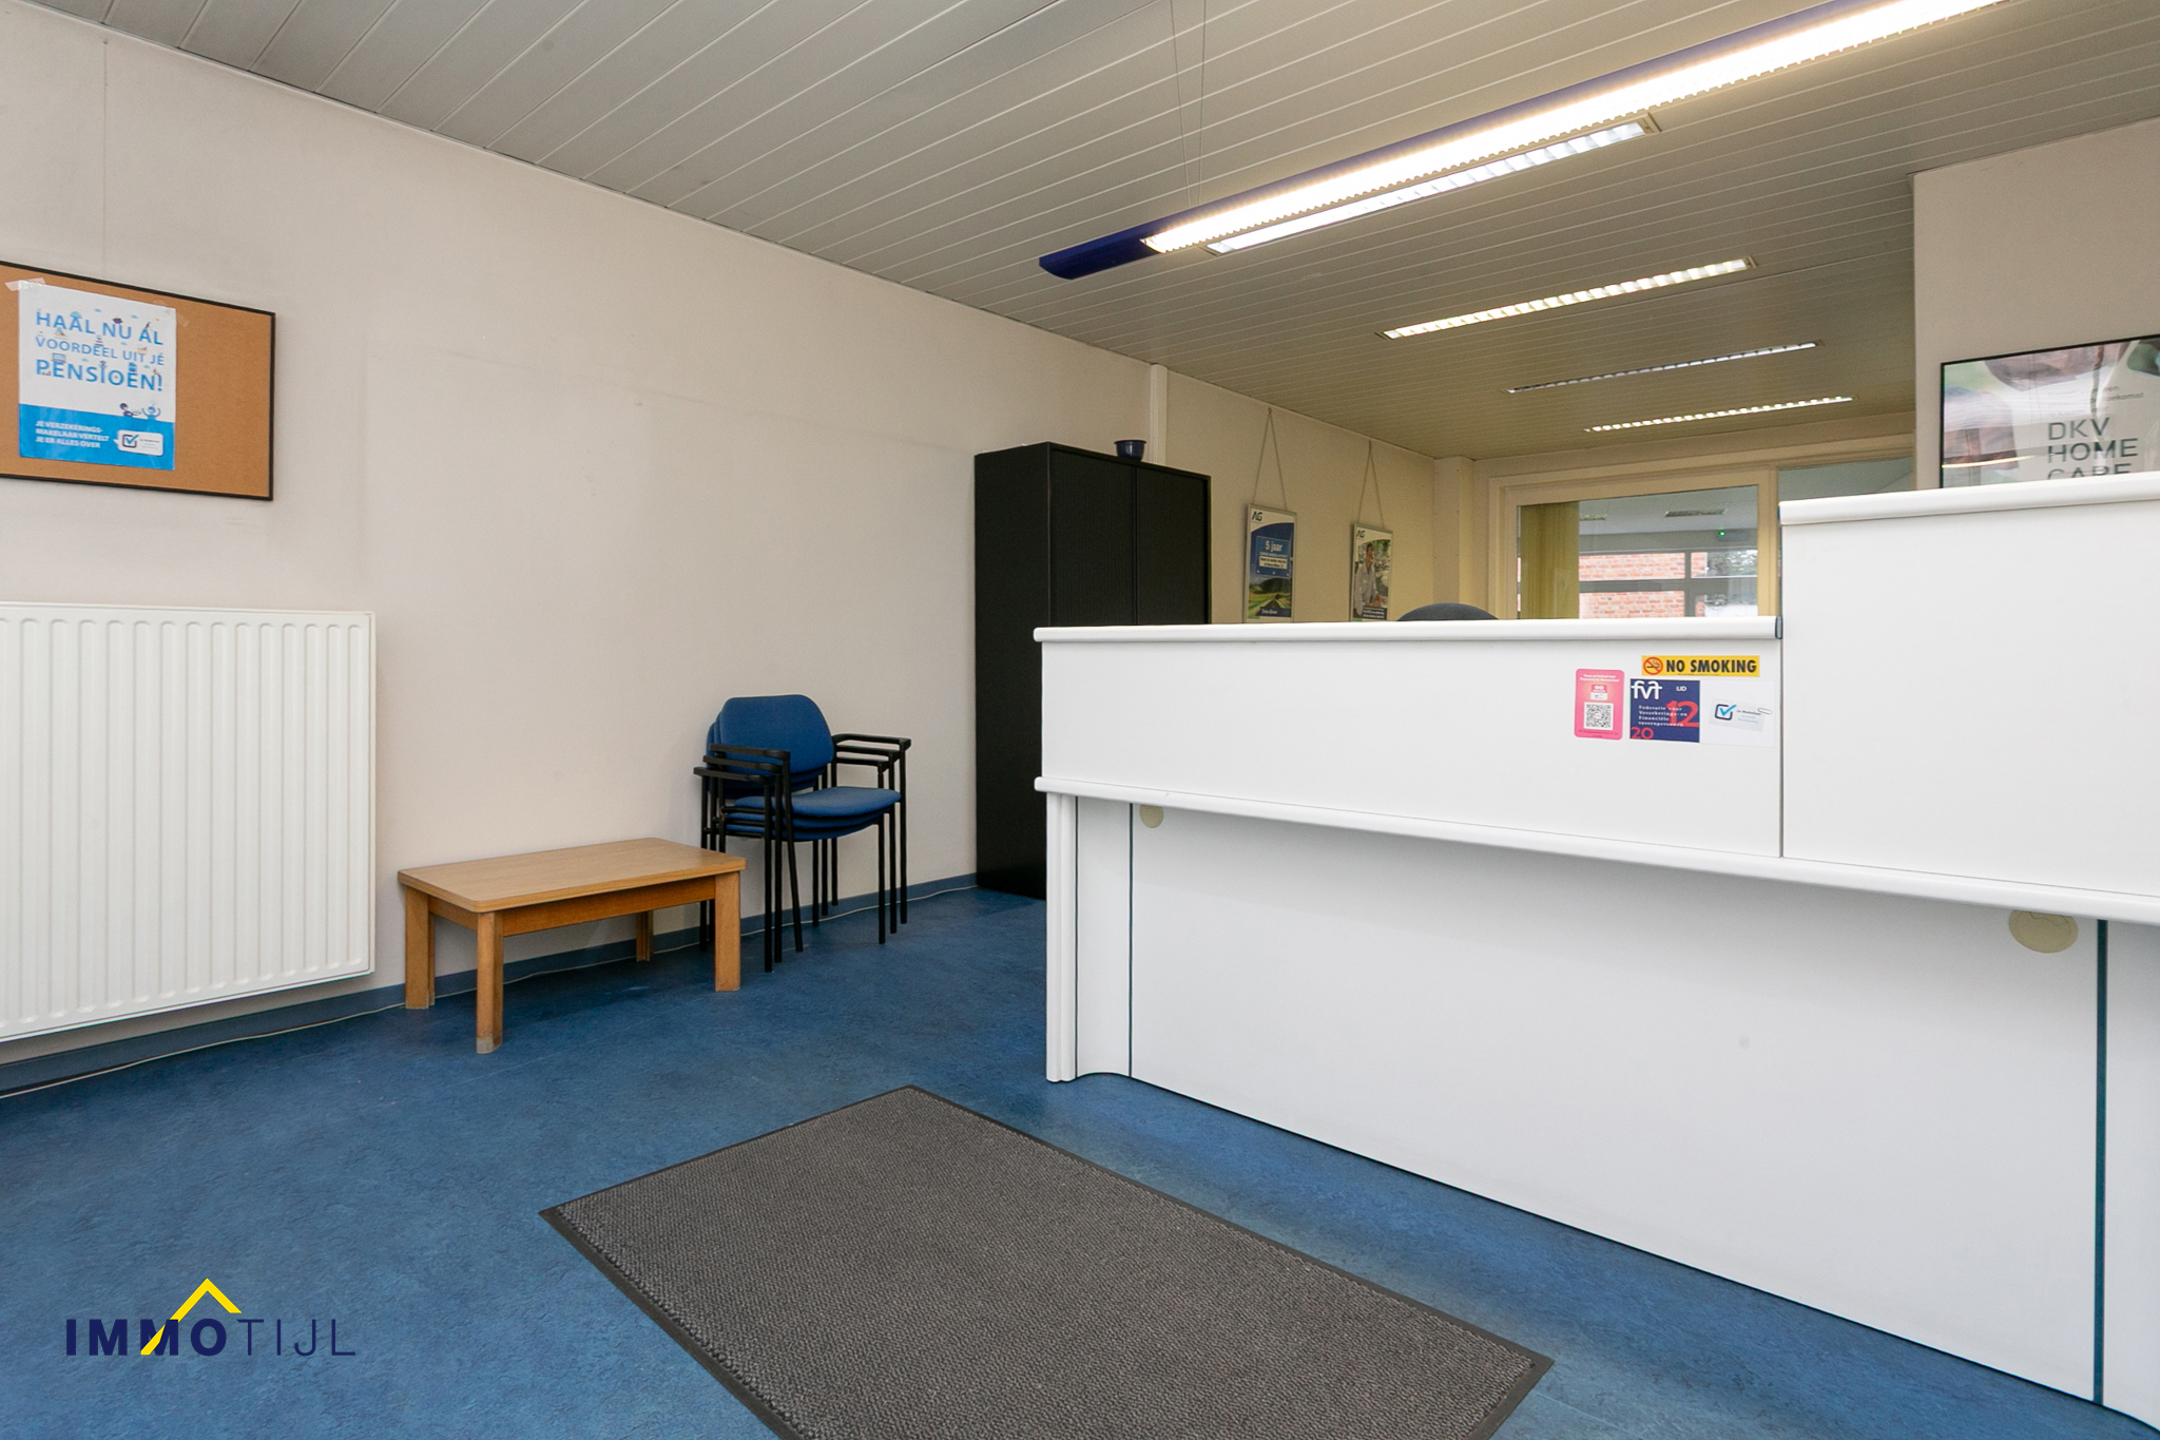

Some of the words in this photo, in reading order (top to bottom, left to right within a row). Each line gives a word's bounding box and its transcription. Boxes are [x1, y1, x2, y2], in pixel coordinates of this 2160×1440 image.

[36, 311, 96, 335] HAAL
[102, 322, 132, 340] NU
[139, 329, 164, 346] AL
[35, 336, 119, 360] VOORDEEL
[122, 350, 146, 363] UIT
[150, 354, 165, 366] JE
[36, 359, 163, 392] PENSIOEN!
[46, 421, 103, 433] VERZEKERINGS-
[2048, 417, 2111, 441] DKV
[57, 438, 80, 447] ALLES
[80, 440, 101, 449] OVER
[2048, 438, 2140, 464] HOME
[1666, 659, 1686, 673] NO
[1690, 659, 1757, 674] SMOKING
[1666, 700, 1700, 728] 12
[1630, 726, 1655, 740] 20
